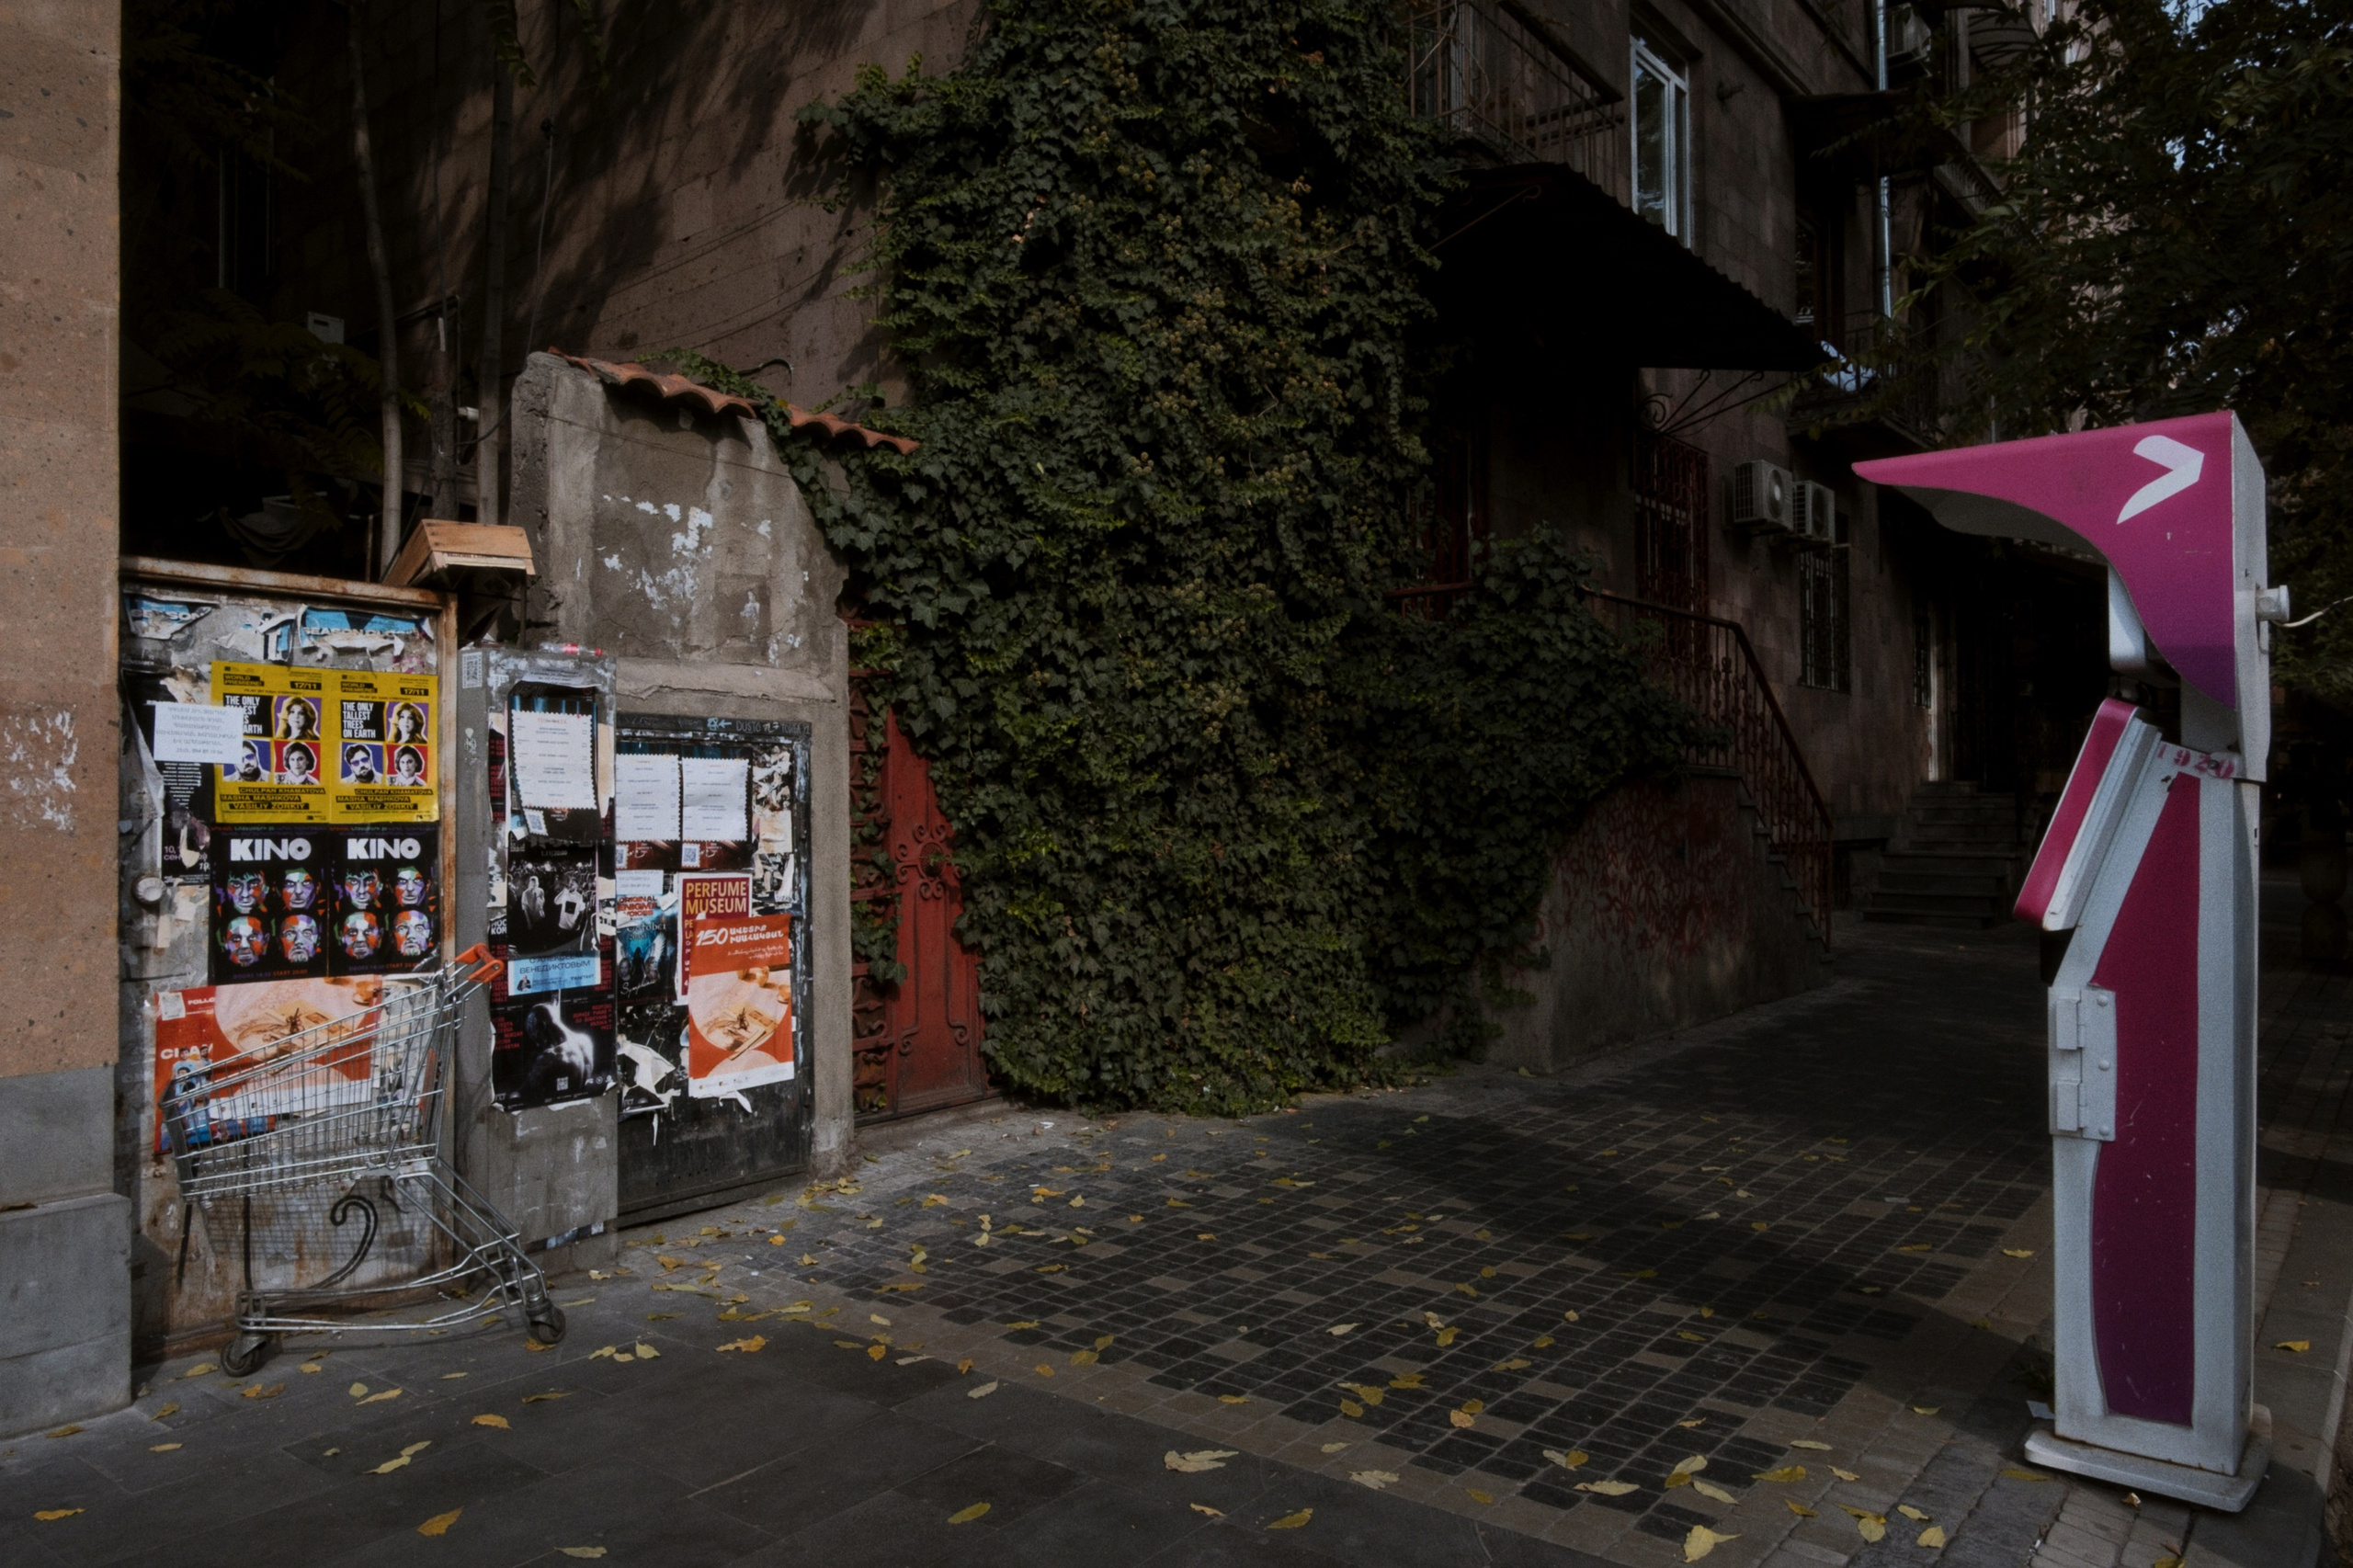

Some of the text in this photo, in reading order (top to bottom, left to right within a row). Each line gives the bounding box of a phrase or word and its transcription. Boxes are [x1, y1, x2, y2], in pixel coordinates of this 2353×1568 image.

[225, 695, 260, 707] THE ONLY
[342, 701, 374, 712] THE ONLY
[342, 710, 371, 721] TALLEST
[243, 724, 263, 734] ARTH
[343, 720, 364, 729] TREES
[343, 729, 376, 738] ON EARTH
[230, 837, 313, 861] KINO
[347, 837, 422, 860] KINO
[686, 881, 746, 899] PERFUME
[619, 895, 658, 904] ORIGINAL
[686, 897, 746, 915] MUSEUM
[730, 925, 767, 936] ԱՎԵՏԻՔ
[696, 927, 729, 947] 150
[730, 930, 784, 944] ԻՍԱՀԱԿՅԱՆ
[519, 960, 591, 974] ВЕНЕДИКТОВЫМ
